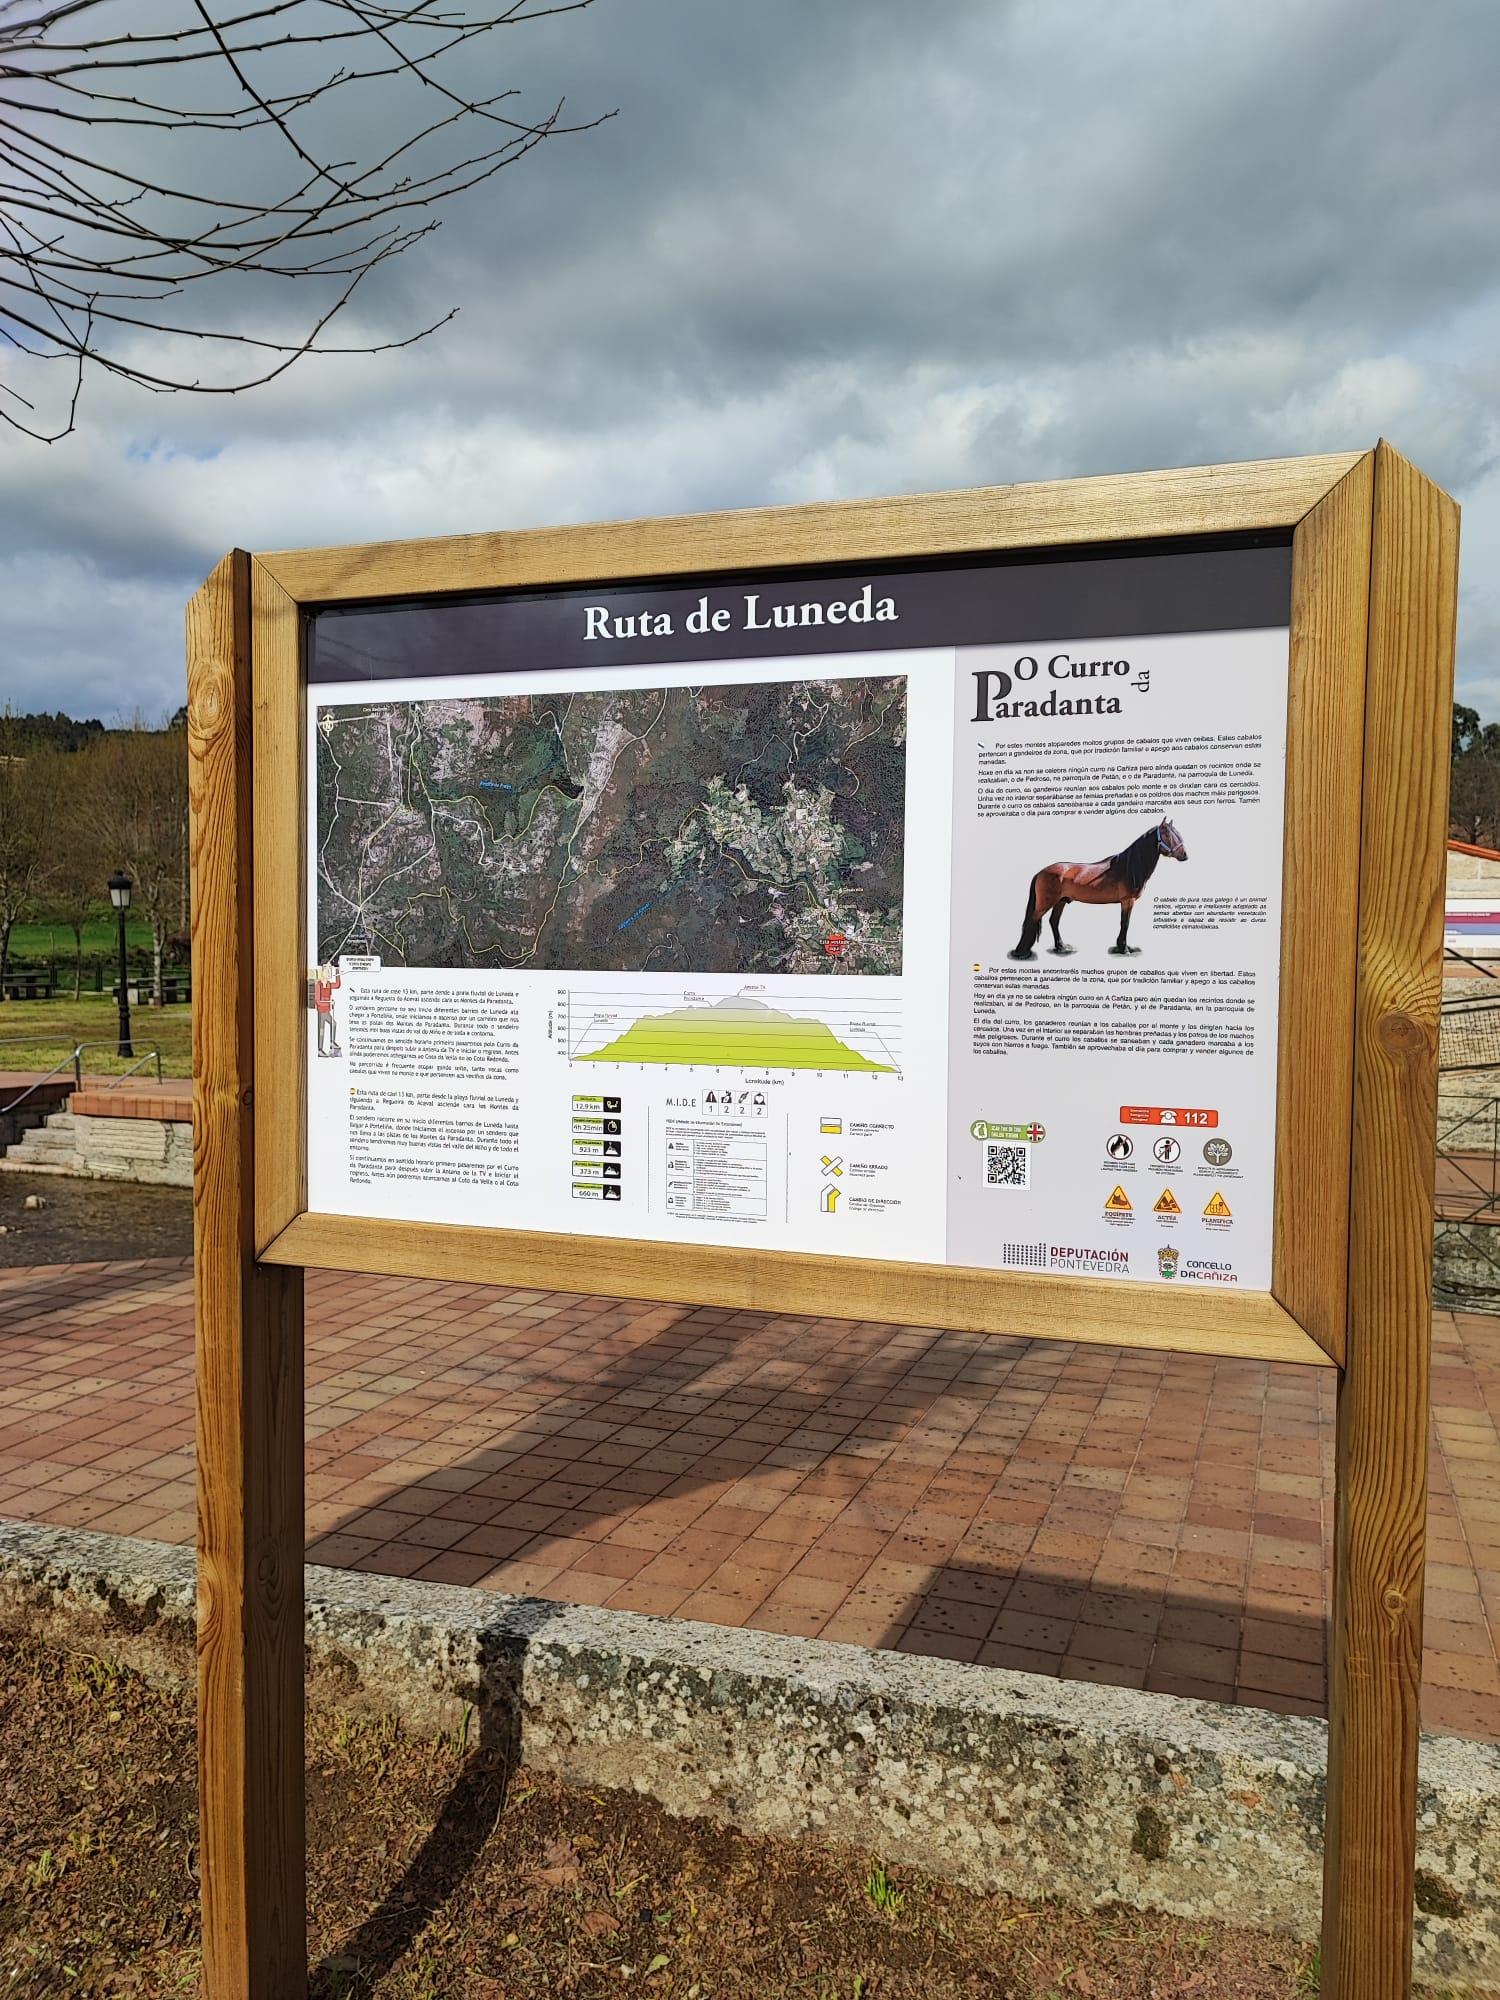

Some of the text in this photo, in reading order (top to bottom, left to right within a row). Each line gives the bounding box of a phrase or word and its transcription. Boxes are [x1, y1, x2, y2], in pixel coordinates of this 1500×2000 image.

[583, 584, 899, 642] Ruta de Luneda
[1014, 654, 1150, 693] O Curro da
[970, 670, 1122, 722] Paradanta
[1184, 1112, 1208, 1124] 112
[1050, 1247, 1129, 1262] DEPUTACIÓN
[1050, 1257, 1130, 1274] PONTEVEDRA
[1187, 1260, 1232, 1270] CONCELLO
